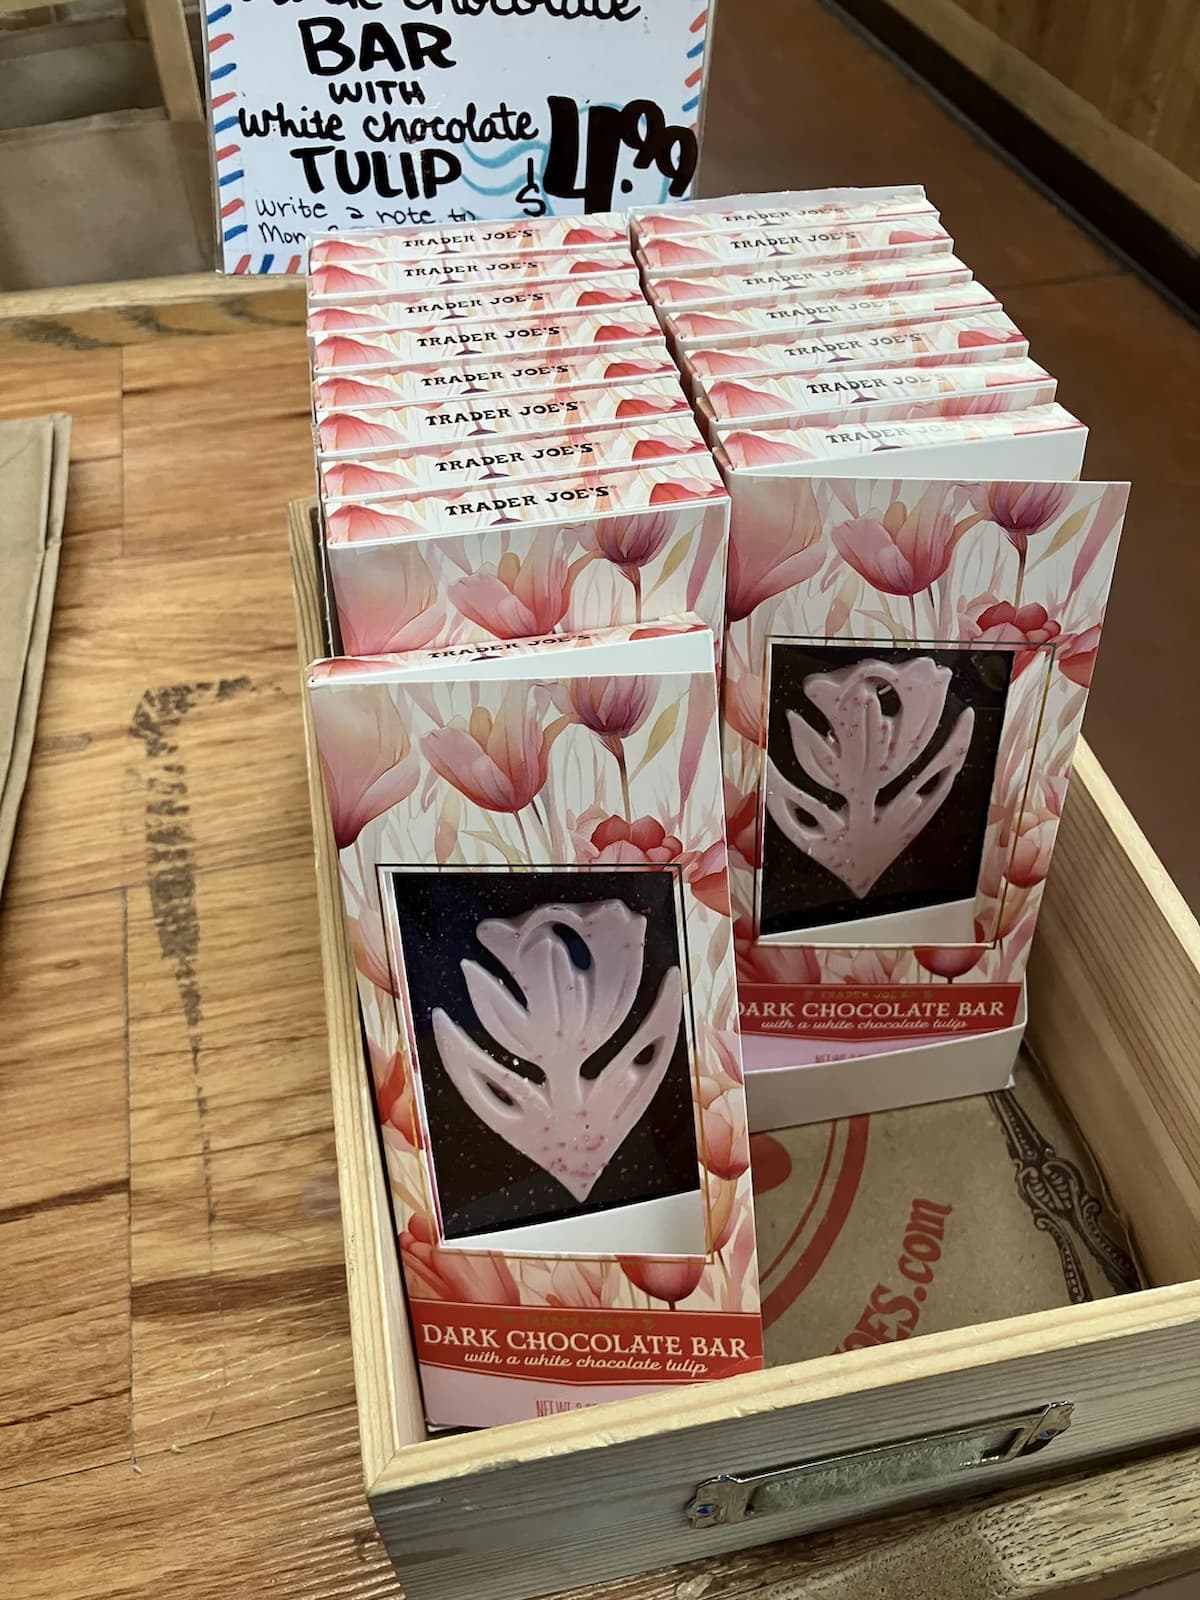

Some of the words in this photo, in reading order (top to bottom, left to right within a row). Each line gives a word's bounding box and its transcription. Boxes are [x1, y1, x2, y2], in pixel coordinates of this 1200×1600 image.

[298, 17, 457, 76] BAR
[328, 79, 427, 105] WITH
[362, 102, 541, 143] chocolate
[289, 145, 463, 200] TULIP
[255, 197, 328, 218] Write
[345, 206, 365, 219] a
[376, 208, 437, 224] note
[403, 235, 475, 248] TRADER
[482, 229, 534, 241] JOE'S
[730, 235, 802, 249] TRADER
[807, 231, 856, 242] JOE'S
[404, 264, 478, 277] TRADER
[486, 261, 539, 272] JOE'S
[742, 272, 815, 286] TRADER
[405, 299, 483, 314] TRADER
[489, 292, 545, 305] JOE'S
[766, 304, 841, 319] TRADER
[416, 331, 497, 347] TRADER
[504, 325, 561, 339] JOE'S
[784, 341, 862, 356] TRADER
[869, 333, 922, 346] JOE'S
[420, 370, 504, 386] TRADER
[512, 364, 569, 378] JOE'S
[806, 377, 885, 394] TRADER
[425, 408, 512, 426] TRADER
[520, 401, 578, 416] JOE'S
[825, 427, 910, 444] TRADER
[435, 453, 523, 472] TRADER
[532, 443, 593, 458] JOE'S
[445, 495, 538, 516] TRADER
[545, 486, 610, 503] JOE'S
[427, 642, 519, 658] TRADER
[528, 635, 591, 647] JOE'S
[801, 1002, 951, 1019] CHOCOLATE
[957, 1001, 1005, 1017] BAR
[760, 1019, 794, 1030] with
[797, 1021, 810, 1030] a
[812, 1018, 854, 1030] white
[857, 1017, 929, 1030] chocolate
[932, 1016, 968, 1030] tulip
[421, 1323, 500, 1350] DARK
[506, 1330, 682, 1356] CHOCOLATE
[690, 1336, 750, 1359] BAR
[464, 1350, 503, 1365] with
[506, 1353, 521, 1365] a
[524, 1353, 573, 1367] white
[575, 1354, 663, 1371] chocolate
[665, 1358, 709, 1377] tulip
